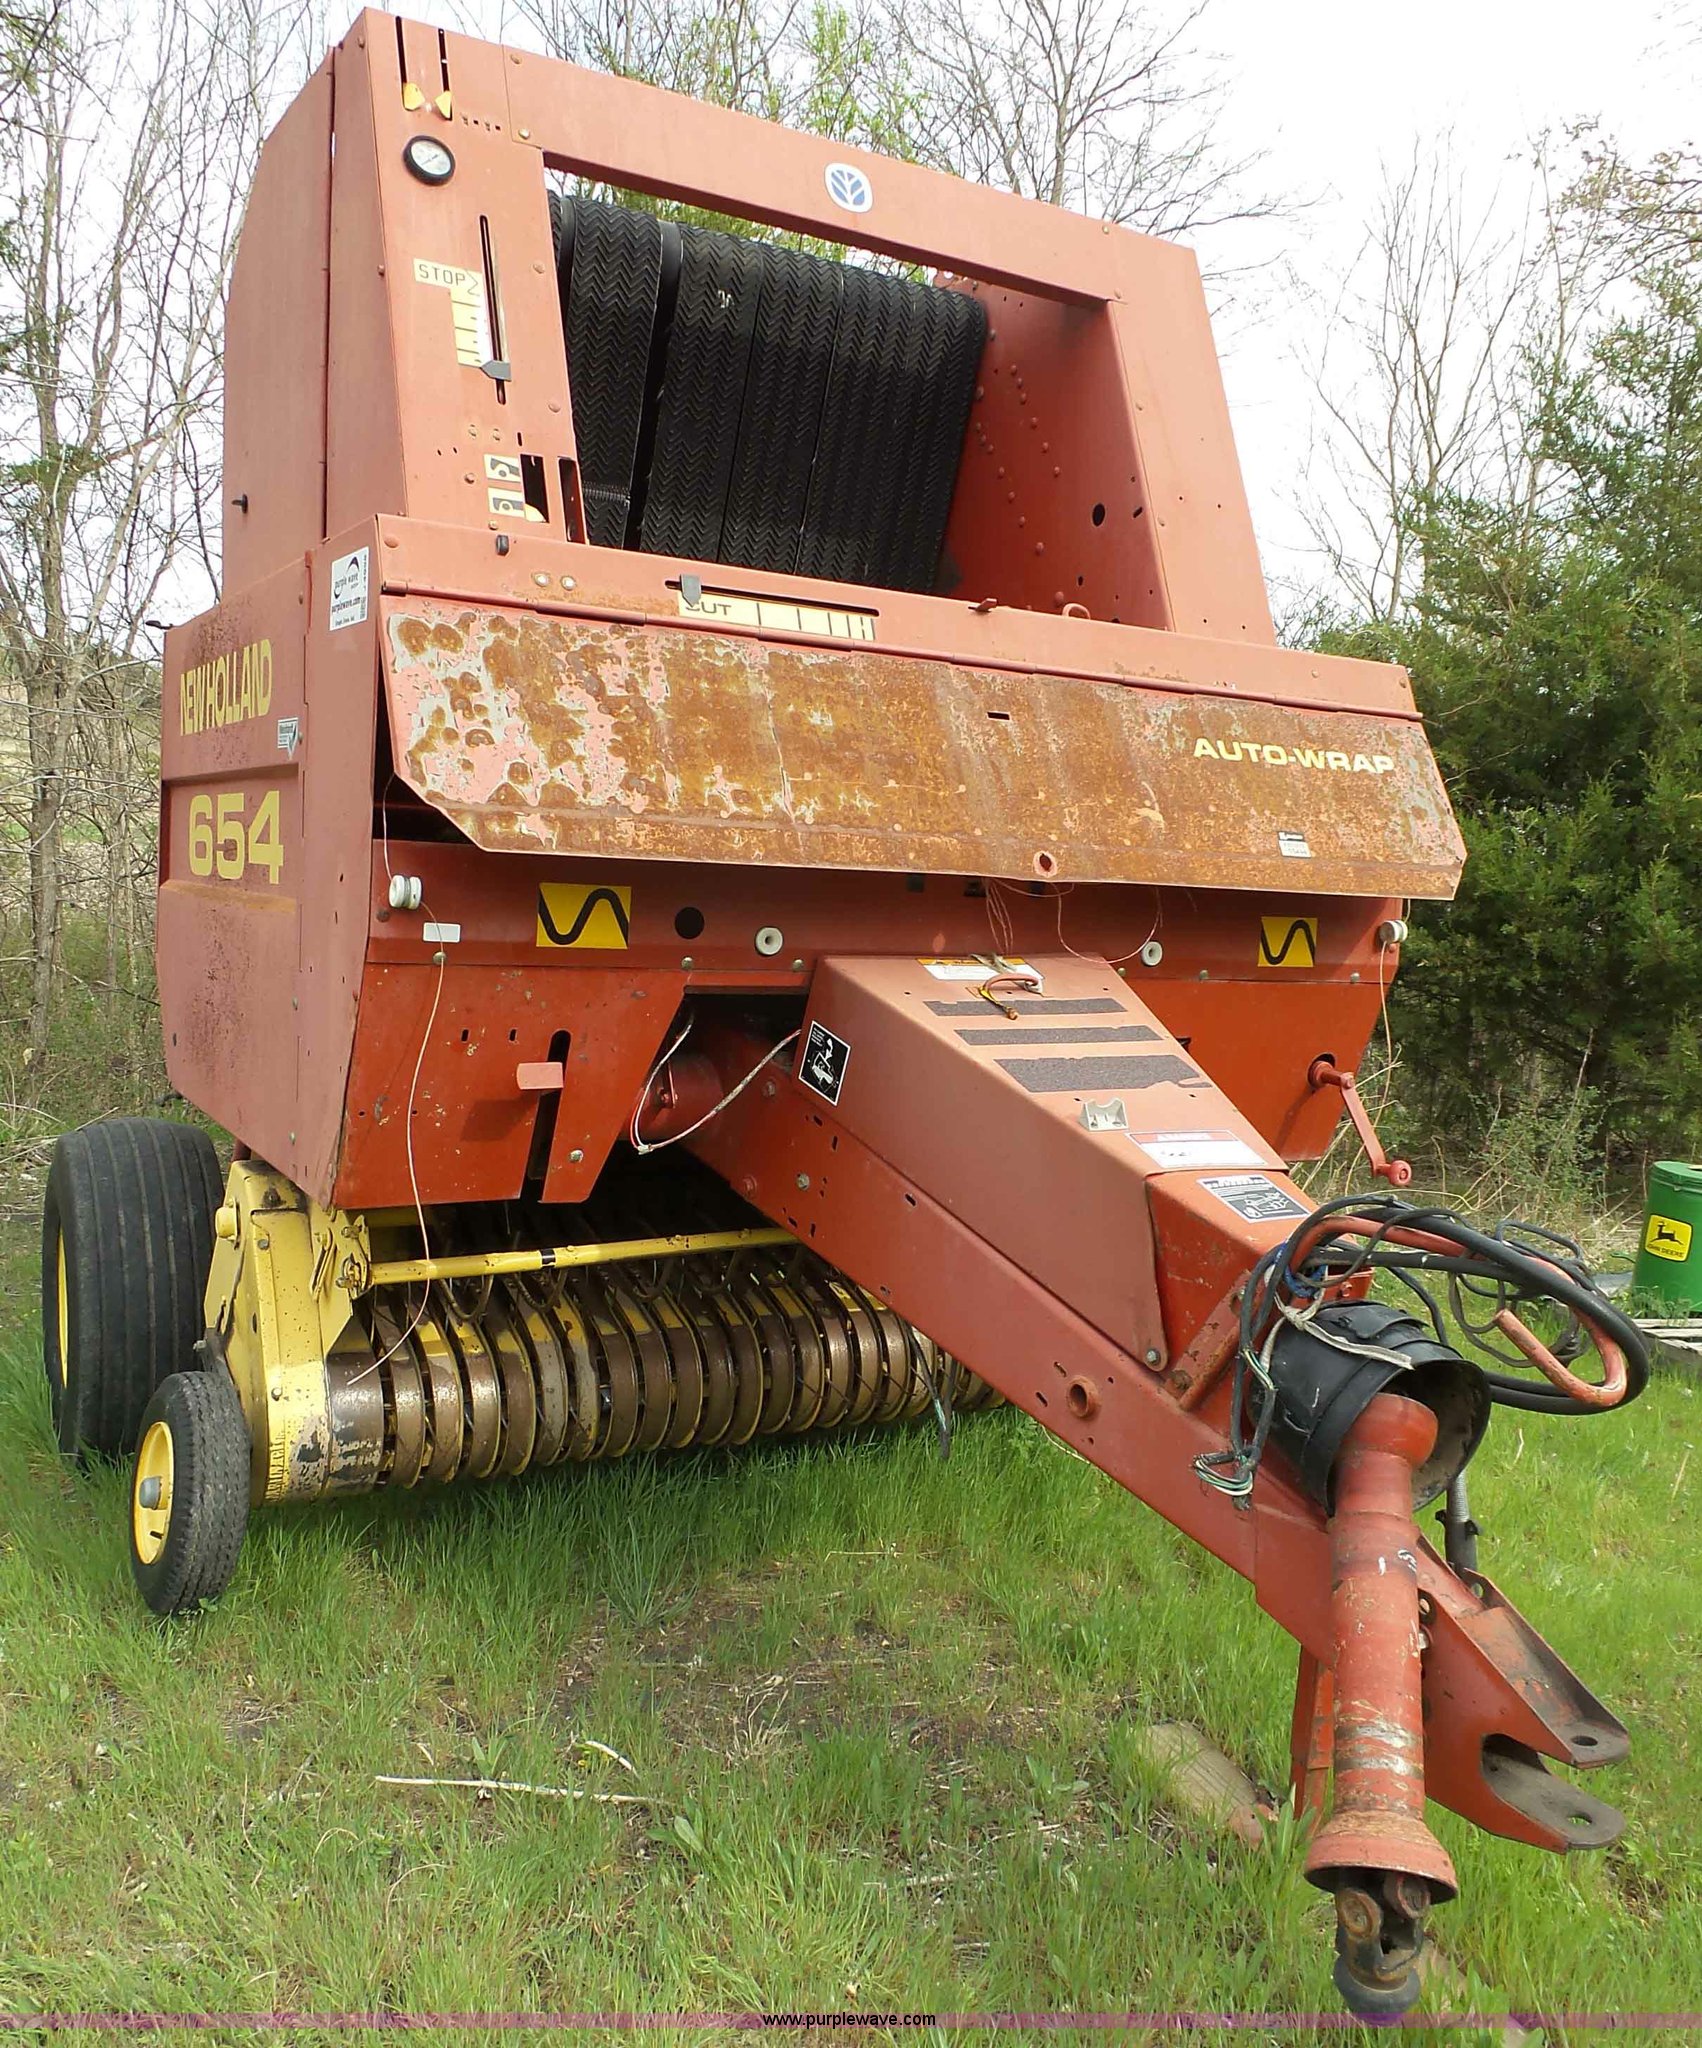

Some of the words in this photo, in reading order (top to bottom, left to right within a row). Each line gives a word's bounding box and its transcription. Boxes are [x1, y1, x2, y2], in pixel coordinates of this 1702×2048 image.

[418, 263, 466, 286] STOP
[1193, 738, 1395, 774] AUTO-WRAP
[189, 790, 284, 885] 654
